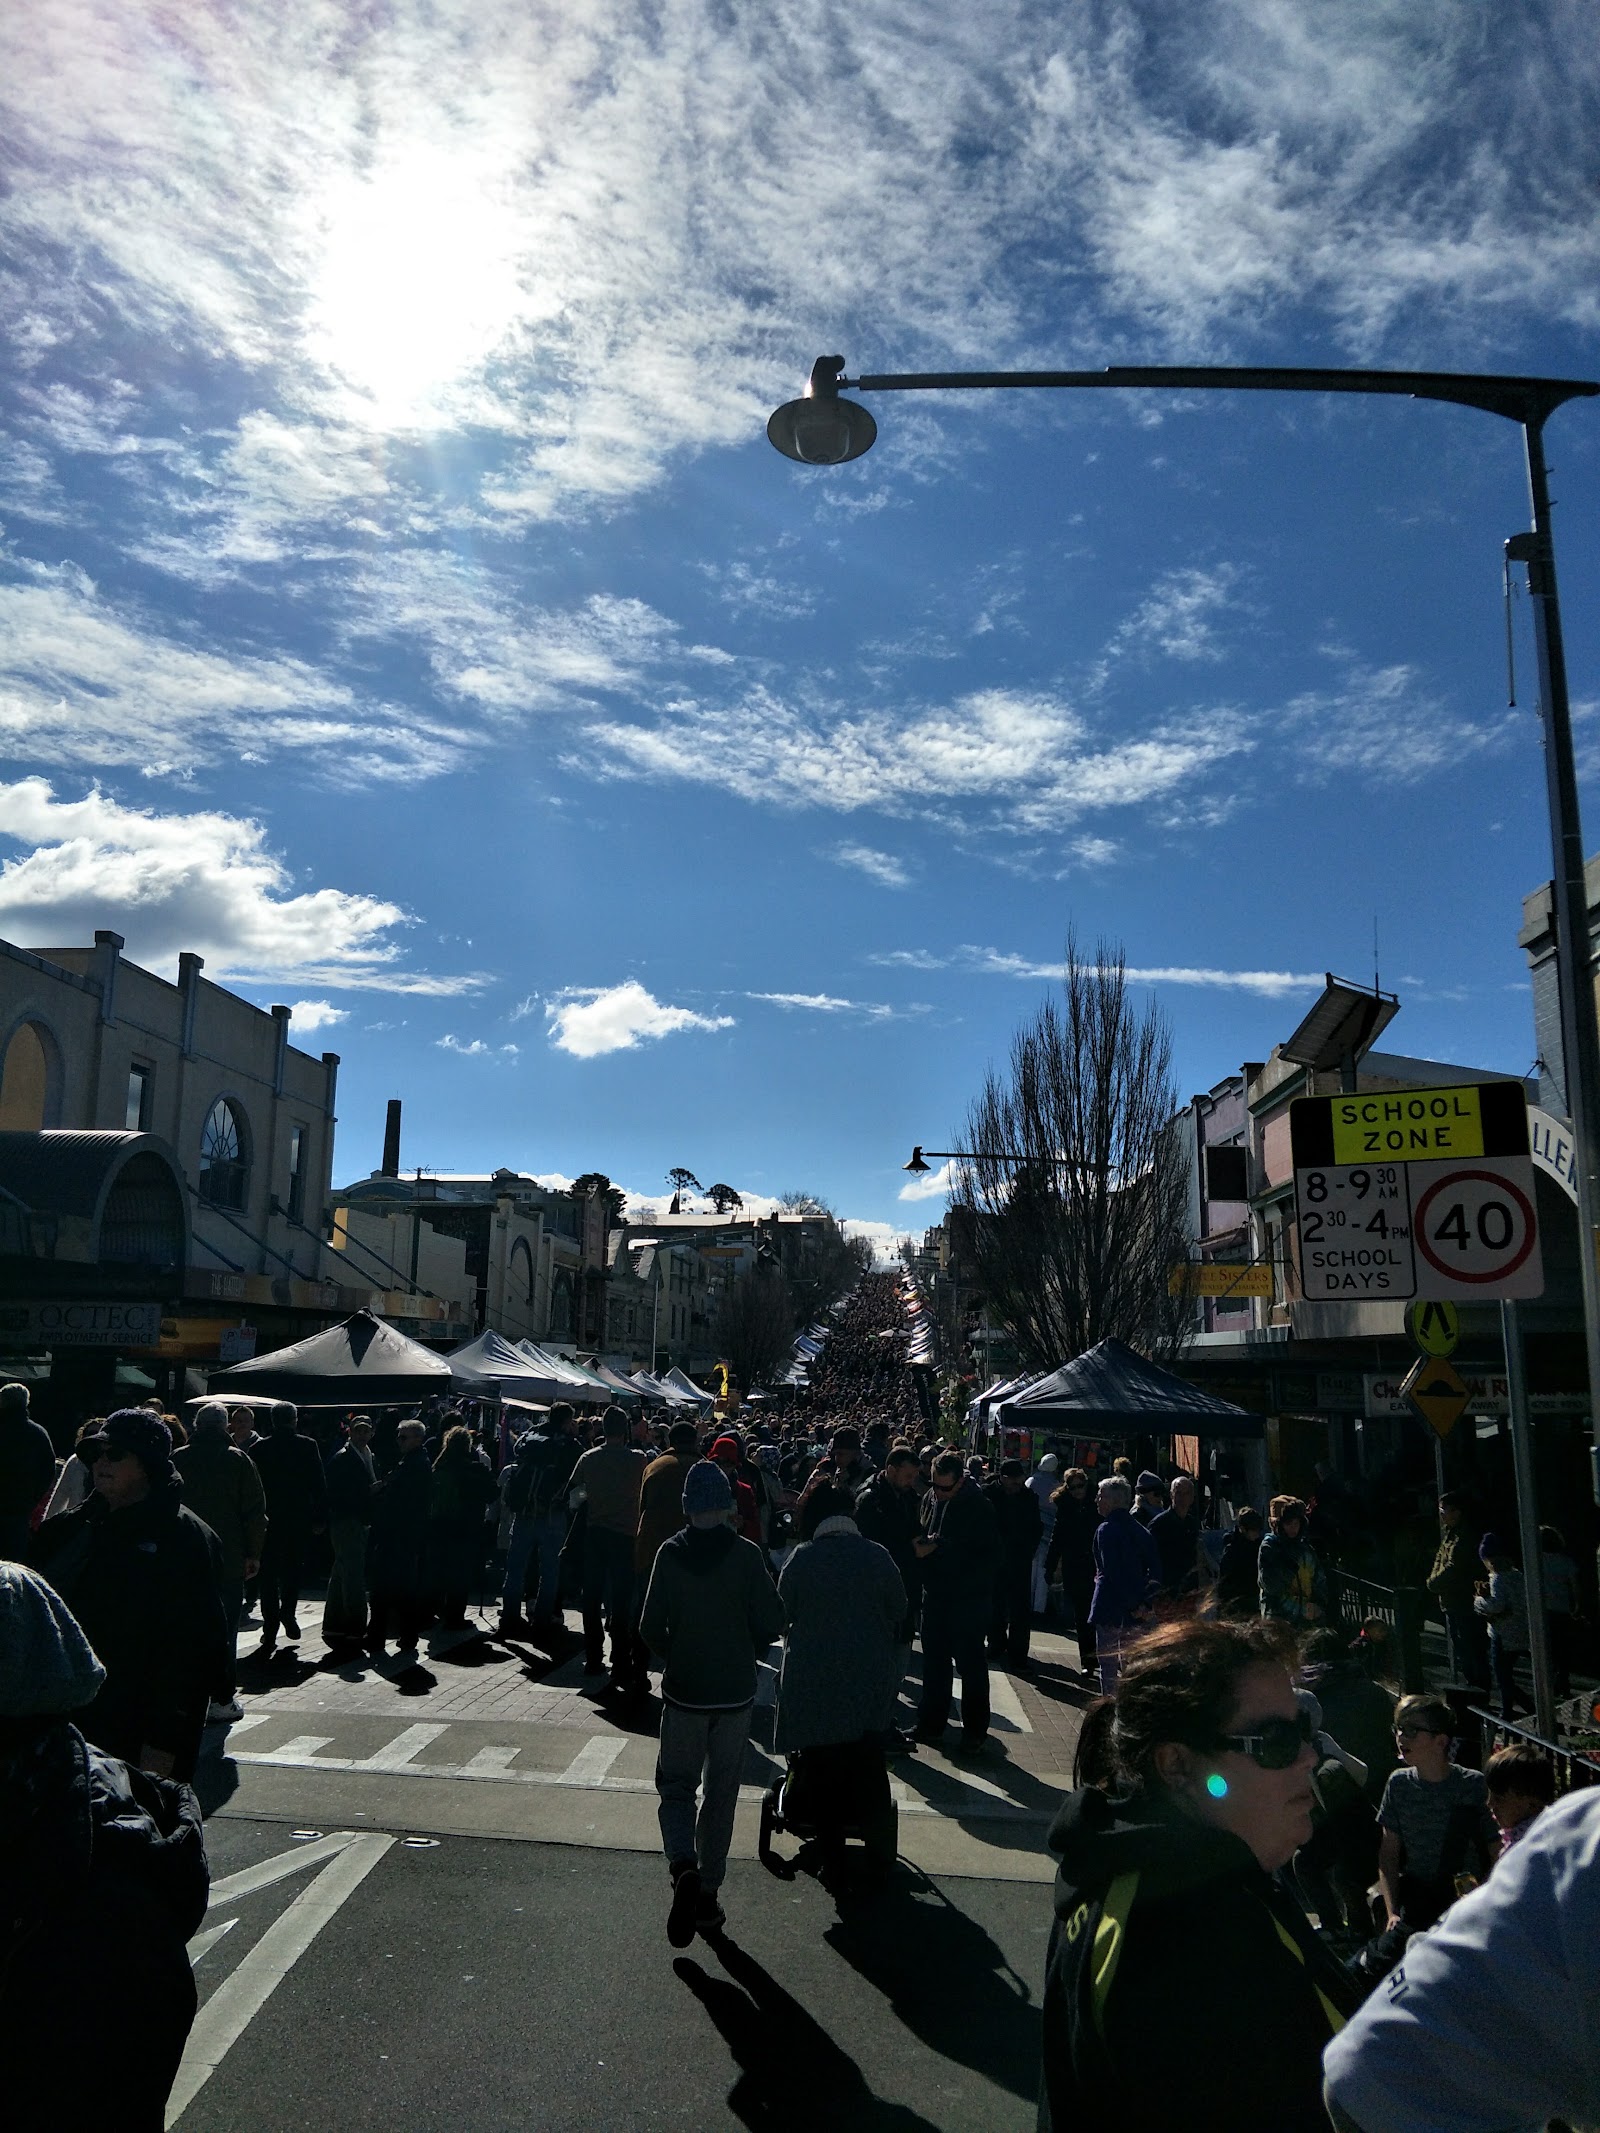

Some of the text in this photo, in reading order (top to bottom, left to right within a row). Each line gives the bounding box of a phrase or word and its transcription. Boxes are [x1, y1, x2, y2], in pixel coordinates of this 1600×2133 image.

[1341, 1097, 1471, 1125] SCHOOL
[1364, 1127, 1452, 1152] ZONE
[1378, 1186, 1399, 1199] AM
[1392, 1226, 1409, 1239] PM
[1433, 1201, 1514, 1251] 40
[1312, 1248, 1402, 1268] SCHOOL
[1326, 1271, 1390, 1290] DAYS
[39, 1305, 145, 1330] OCTEC
[38, 1331, 154, 1344] EMPLOYMENT SERVICE
[1471, 1401, 1500, 1409] AWAY
